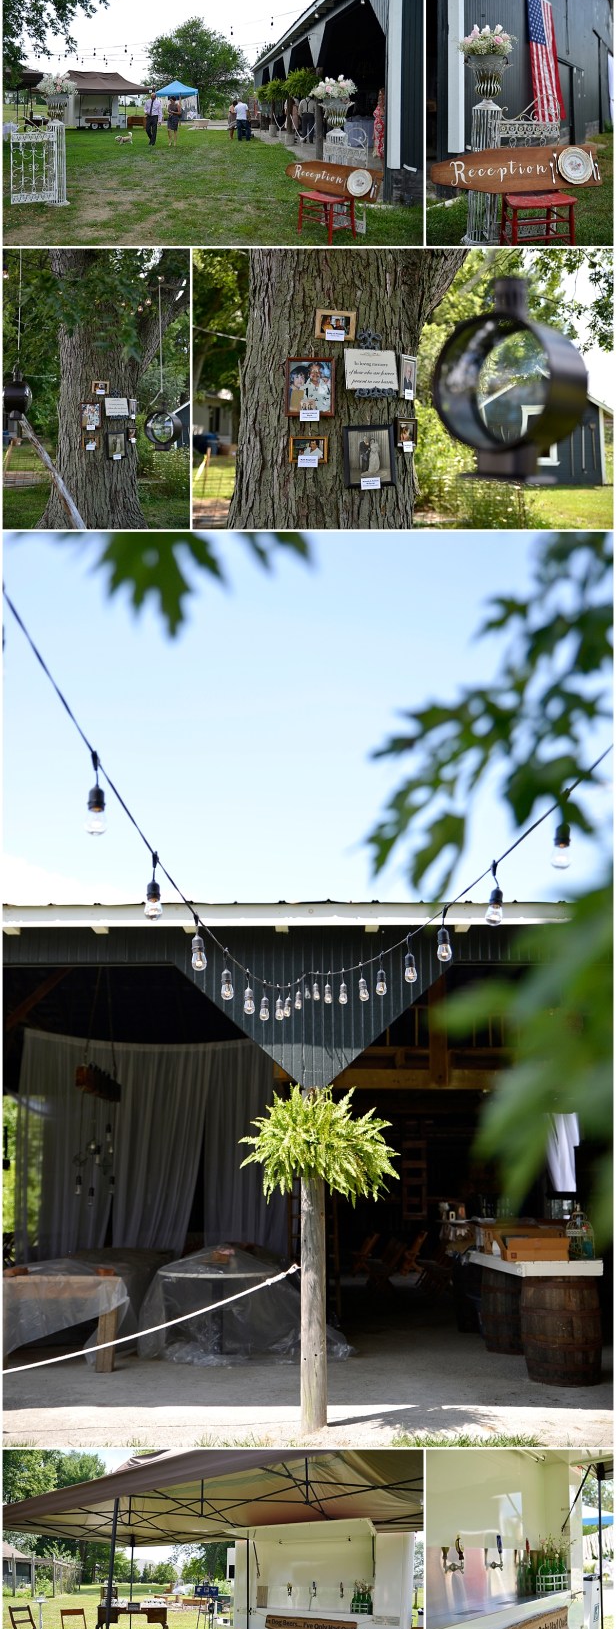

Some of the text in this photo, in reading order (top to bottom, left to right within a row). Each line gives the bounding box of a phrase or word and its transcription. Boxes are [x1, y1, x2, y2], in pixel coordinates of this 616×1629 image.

[292, 164, 344, 183] Reception
[450, 160, 547, 186] Reception
[272, 1619, 282, 1627] Dog
